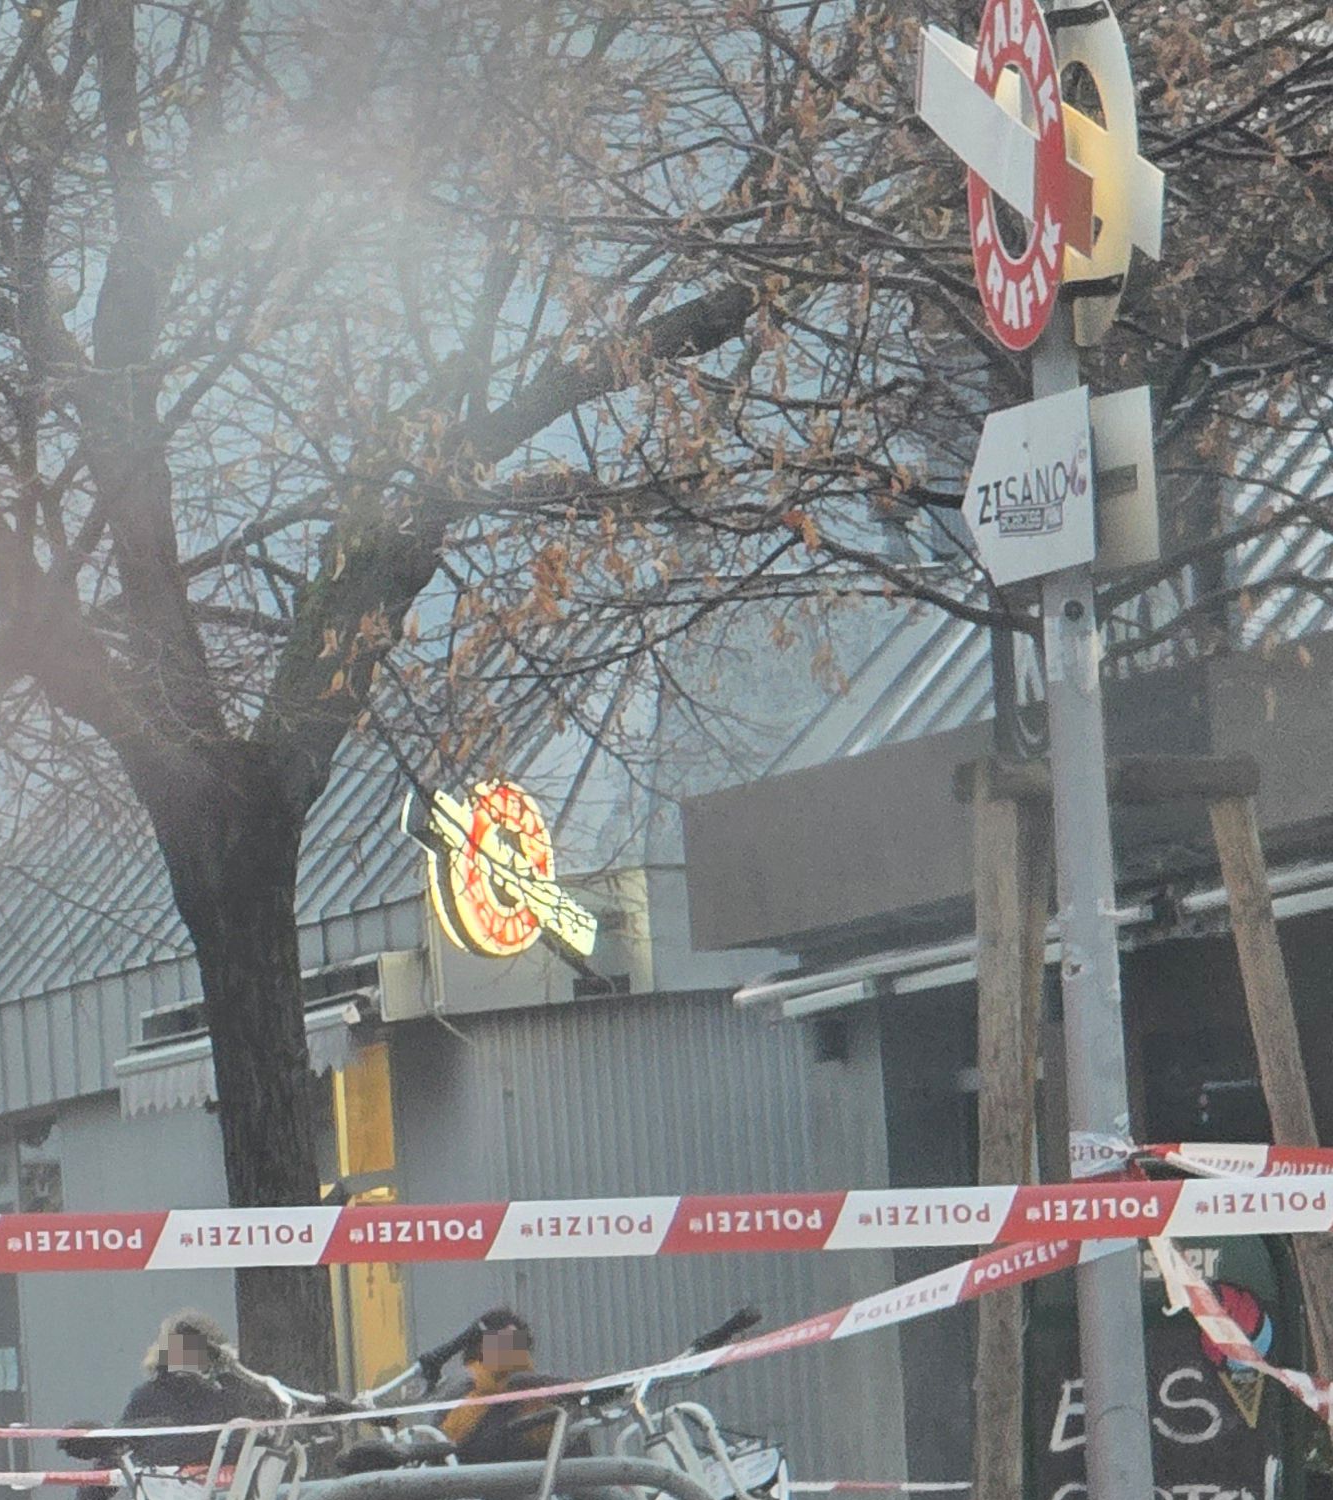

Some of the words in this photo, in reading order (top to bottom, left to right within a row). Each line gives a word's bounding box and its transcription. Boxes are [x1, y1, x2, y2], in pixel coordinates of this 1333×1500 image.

[980, 0, 1059, 138] TABAK
[976, 197, 1061, 330] TRAFIK
[977, 461, 1069, 525] ZISANO
[876, 1203, 991, 1227] POLIZEI
[1044, 1196, 1159, 1221] POLIZEI
[1213, 1191, 1326, 1214] POLIZEI
[368, 1219, 483, 1243] POLIZEI
[539, 1214, 653, 1237] POLIZEI
[707, 1208, 823, 1233] POLIZEI
[26, 1228, 143, 1252] POLIZEI
[199, 1224, 313, 1247] POLIZEI
[854, 1289, 938, 1325] POLIZEI
[973, 1241, 1057, 1285] POLIZEI
[1049, 1368, 1222, 1453] ES
